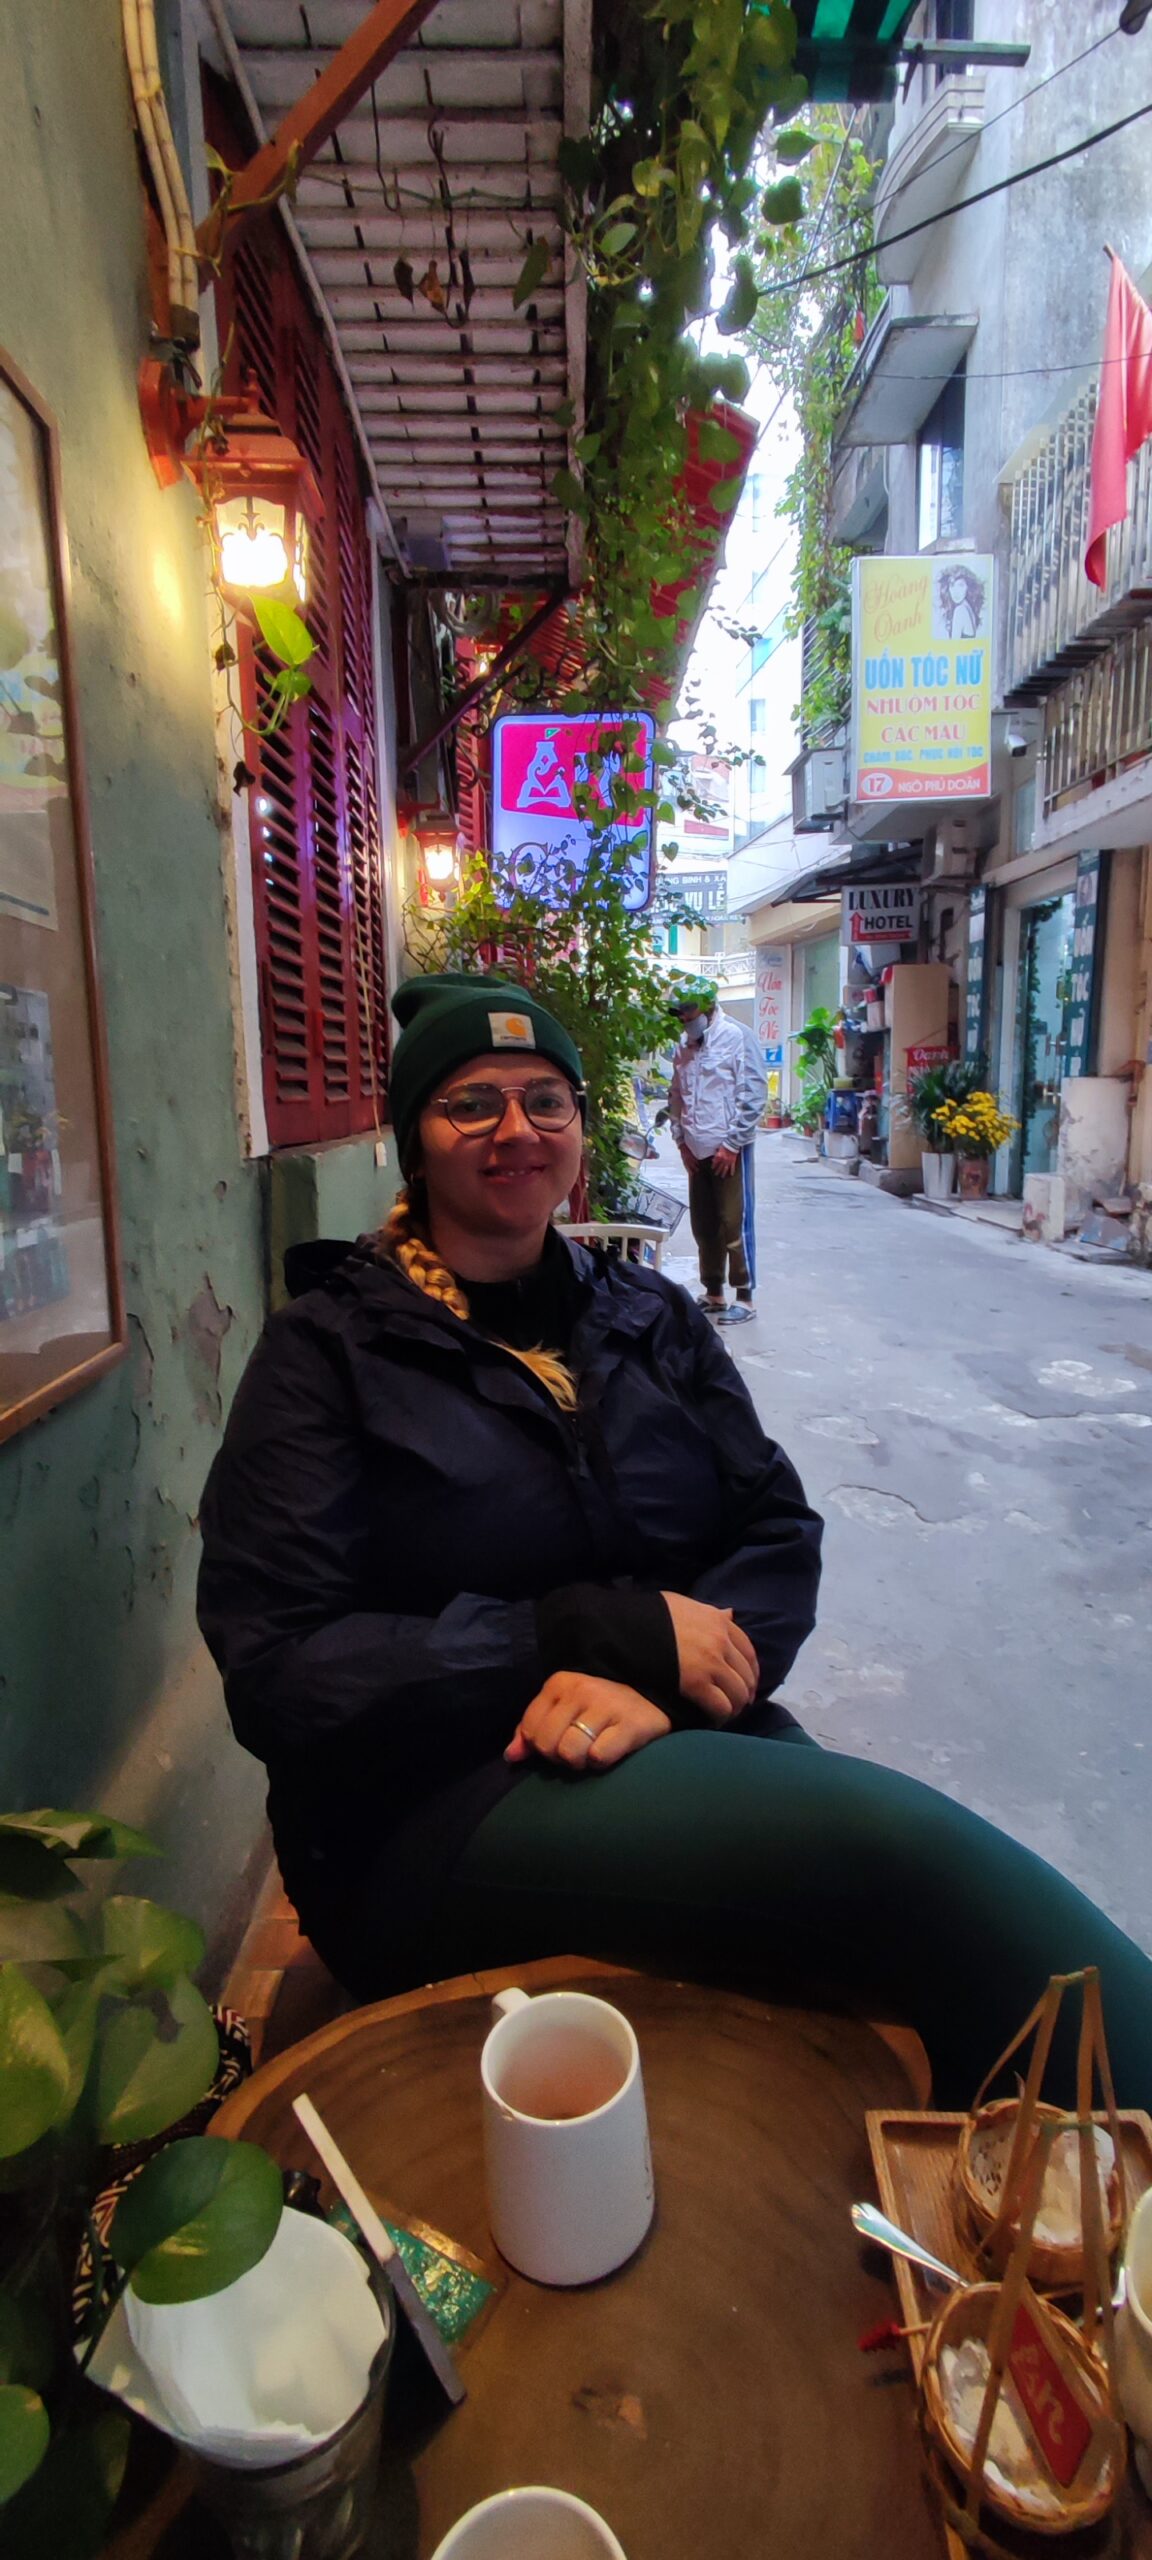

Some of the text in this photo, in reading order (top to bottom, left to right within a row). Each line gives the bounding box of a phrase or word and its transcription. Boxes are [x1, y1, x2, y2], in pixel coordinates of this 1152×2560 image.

[874, 600, 923, 642] Oanh
[865, 647, 984, 690] UỐN TÓC NỮ
[868, 777, 886, 793] 17
[848, 887, 914, 911] LUXURY
[864, 915, 913, 930] HOTEL
